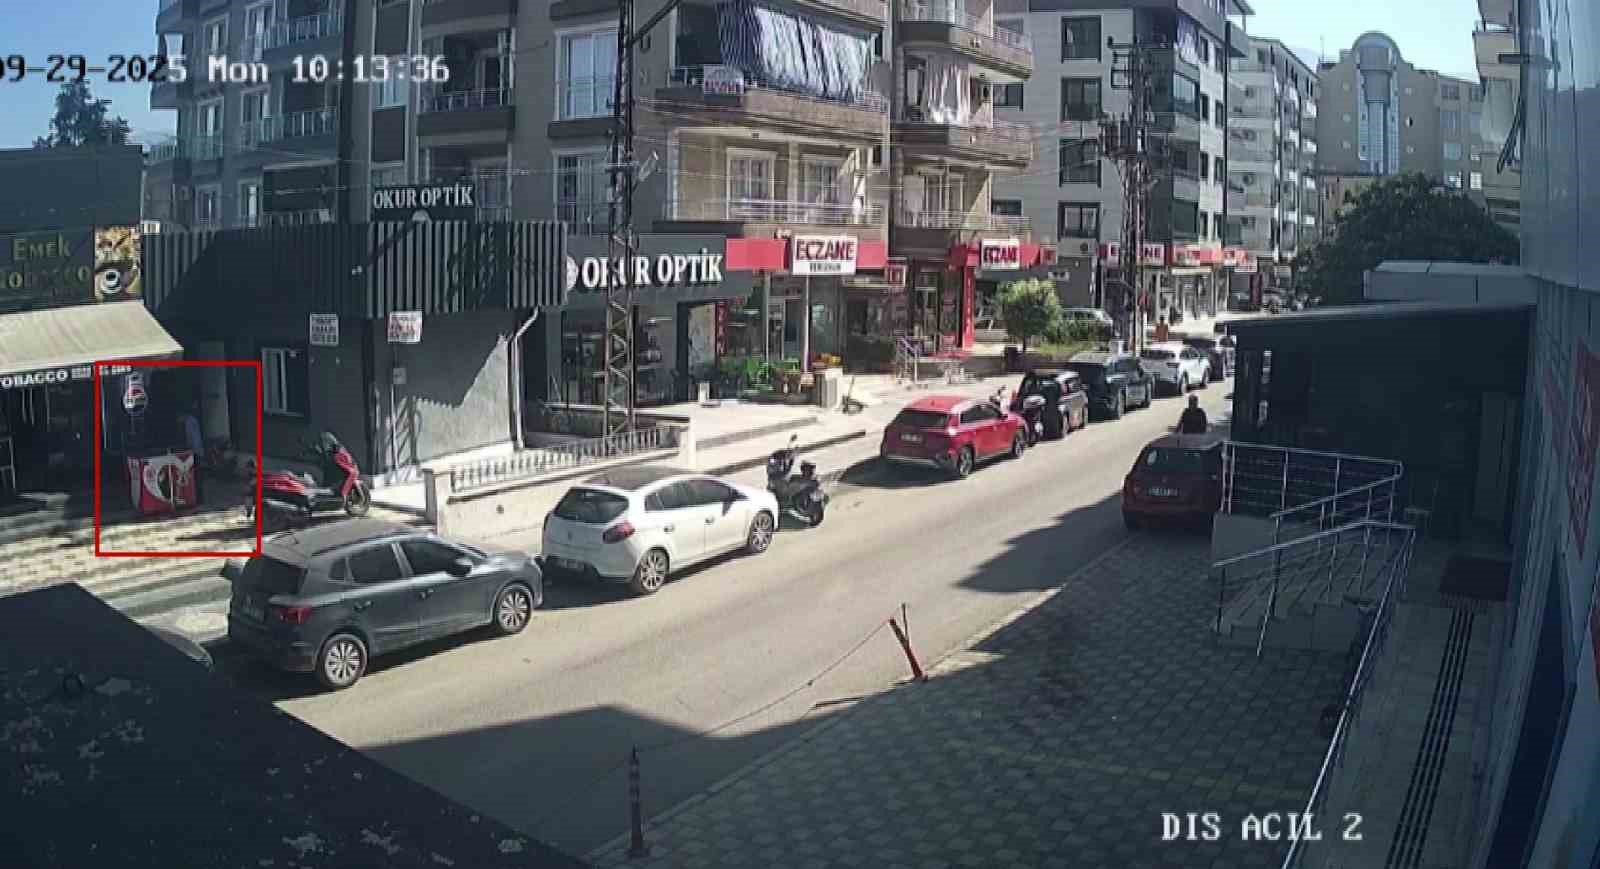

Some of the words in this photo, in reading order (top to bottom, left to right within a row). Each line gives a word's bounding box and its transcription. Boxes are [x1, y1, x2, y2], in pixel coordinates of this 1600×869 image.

[374, 187, 417, 208] OKUR
[421, 182, 473, 206] OPTİK
[795, 239, 855, 261] ECZANE
[657, 248, 723, 283] OPTİK
[0, 367, 68, 389] OBACCO
